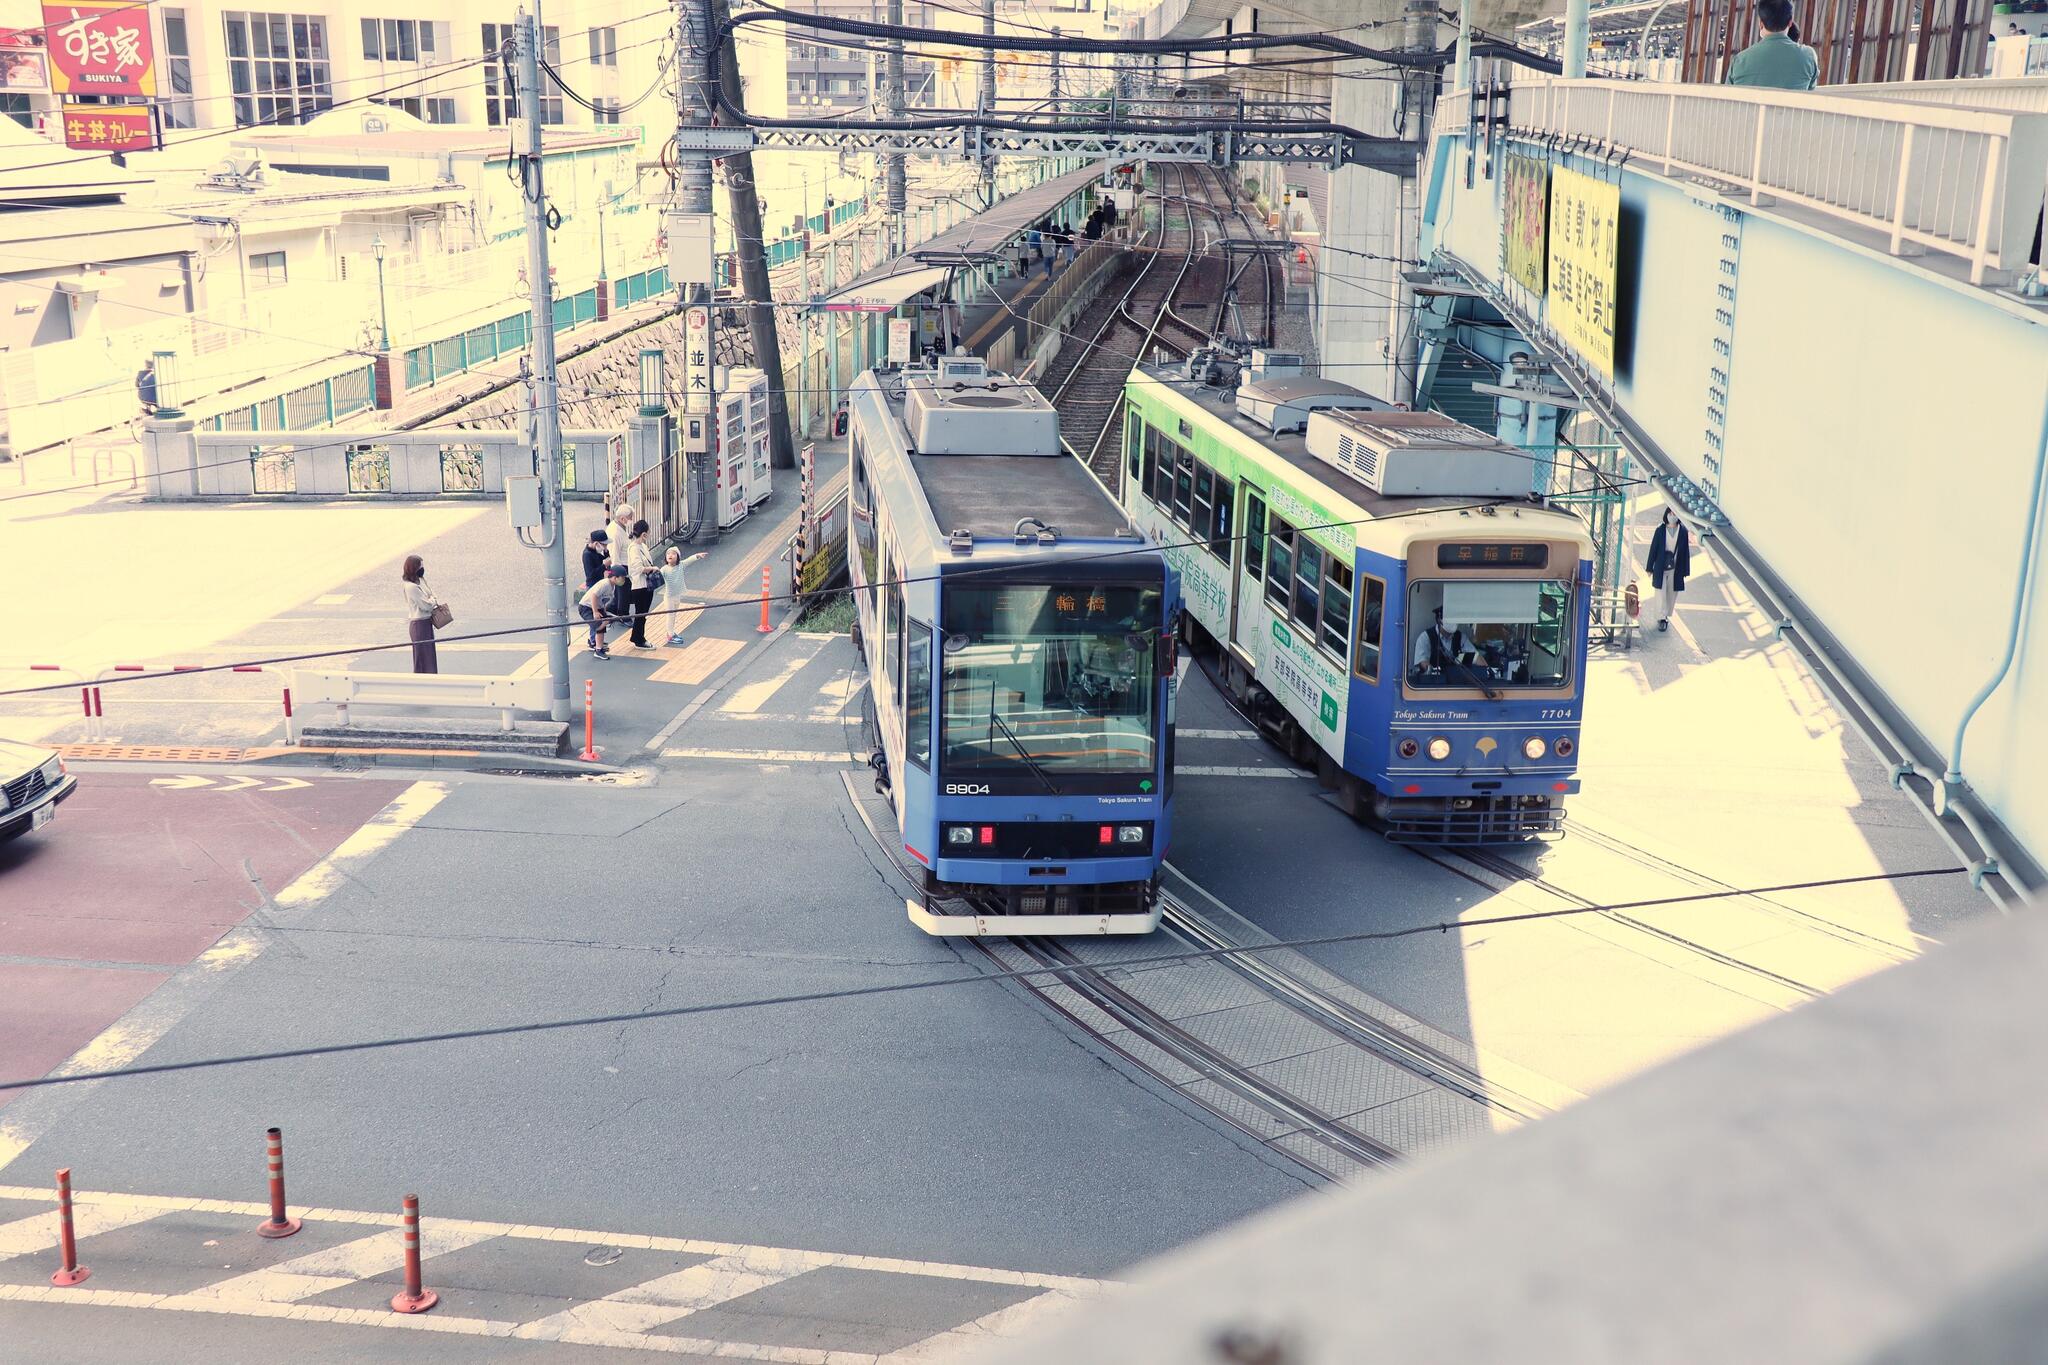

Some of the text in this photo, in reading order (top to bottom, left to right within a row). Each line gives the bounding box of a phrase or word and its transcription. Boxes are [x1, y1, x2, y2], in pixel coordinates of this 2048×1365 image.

[57, 8, 144, 73] すき家
[85, 74, 122, 83] SUKIYA
[690, 350, 706, 389] 並木
[1456, 546, 1525, 561] 早稲田
[995, 592, 1106, 612] 三ノ輪橋
[1274, 655, 1319, 710] 安部学院高等学校
[1394, 710, 1469, 722] Tokyo Sakura Tram
[1541, 709, 1572, 719] 7704
[945, 783, 990, 795] 8904
